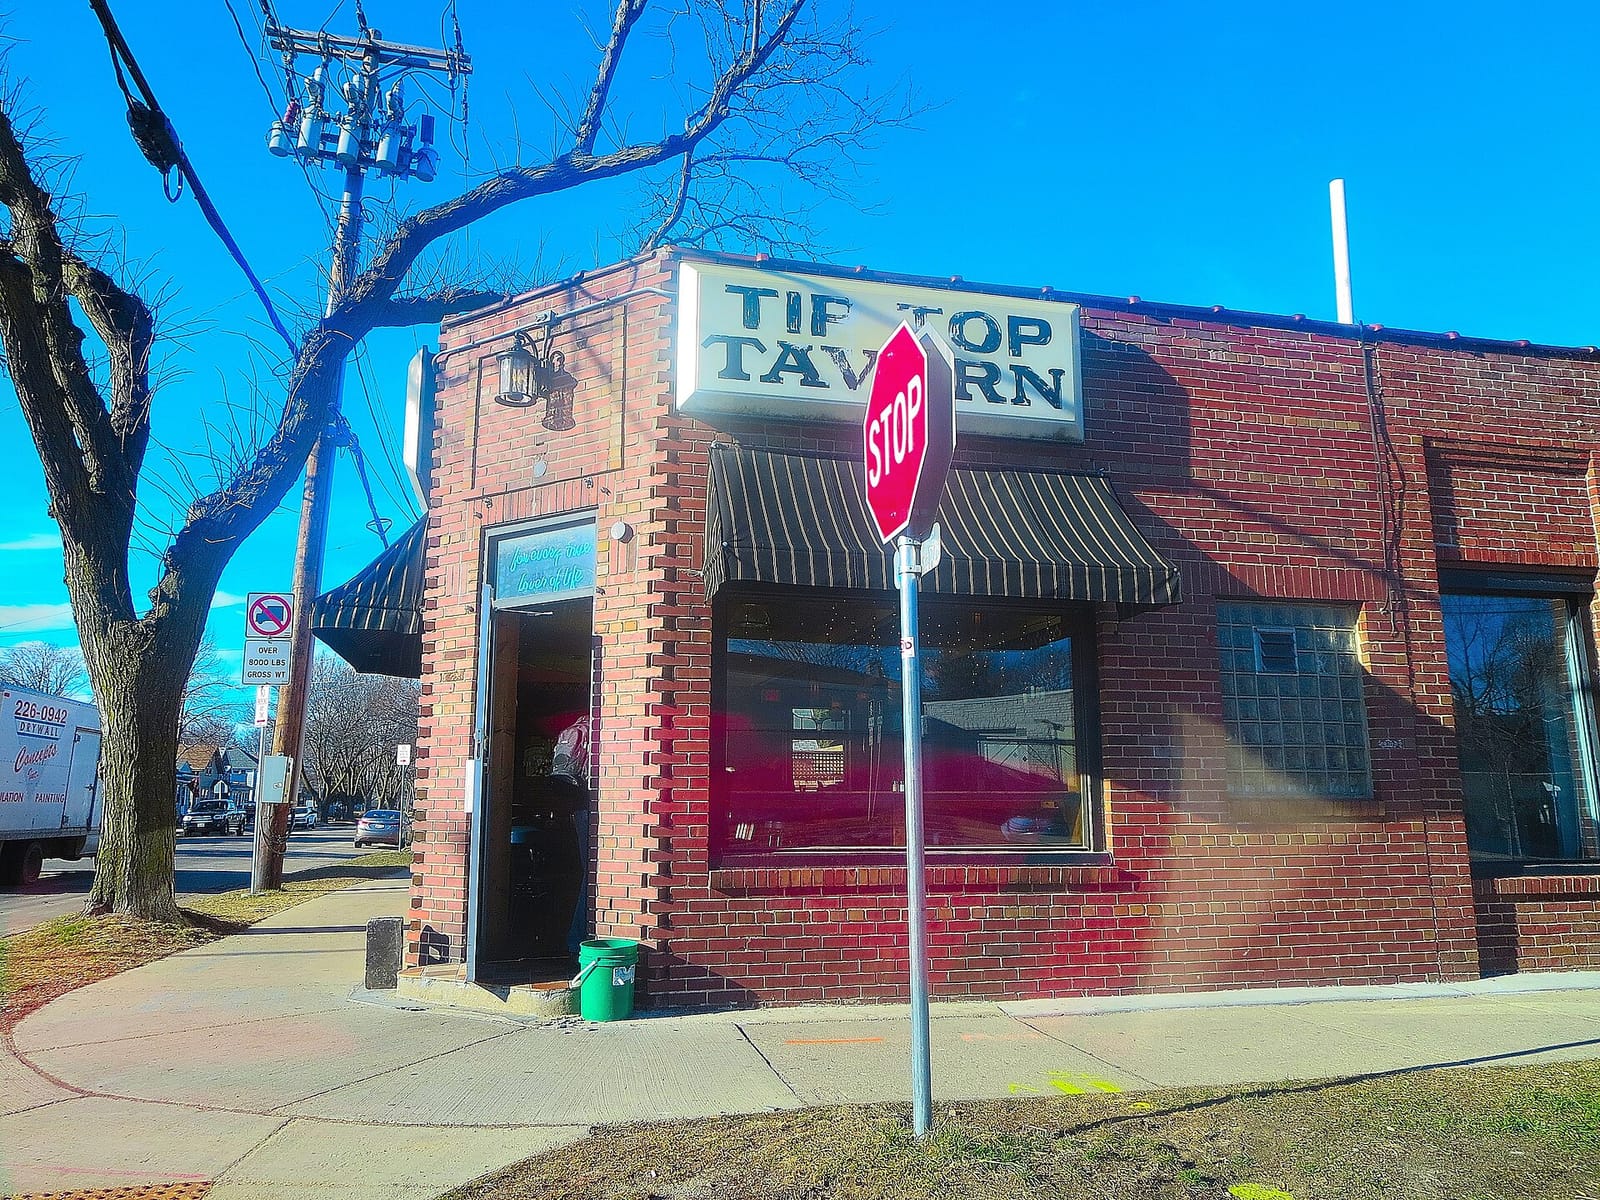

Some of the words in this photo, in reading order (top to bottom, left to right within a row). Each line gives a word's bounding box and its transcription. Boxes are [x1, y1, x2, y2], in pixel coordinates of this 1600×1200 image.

[725, 284, 853, 337] TIP
[897, 303, 1052, 357] TOP
[701, 334, 1066, 409] TAVRN
[868, 374, 922, 488] STOP
[518, 572, 548, 593] lover
[549, 569, 562, 593] of
[14, 700, 68, 724] 226-0942
[20, 721, 59, 737] DRYWALL
[35, 793, 65, 803] PAINTING
